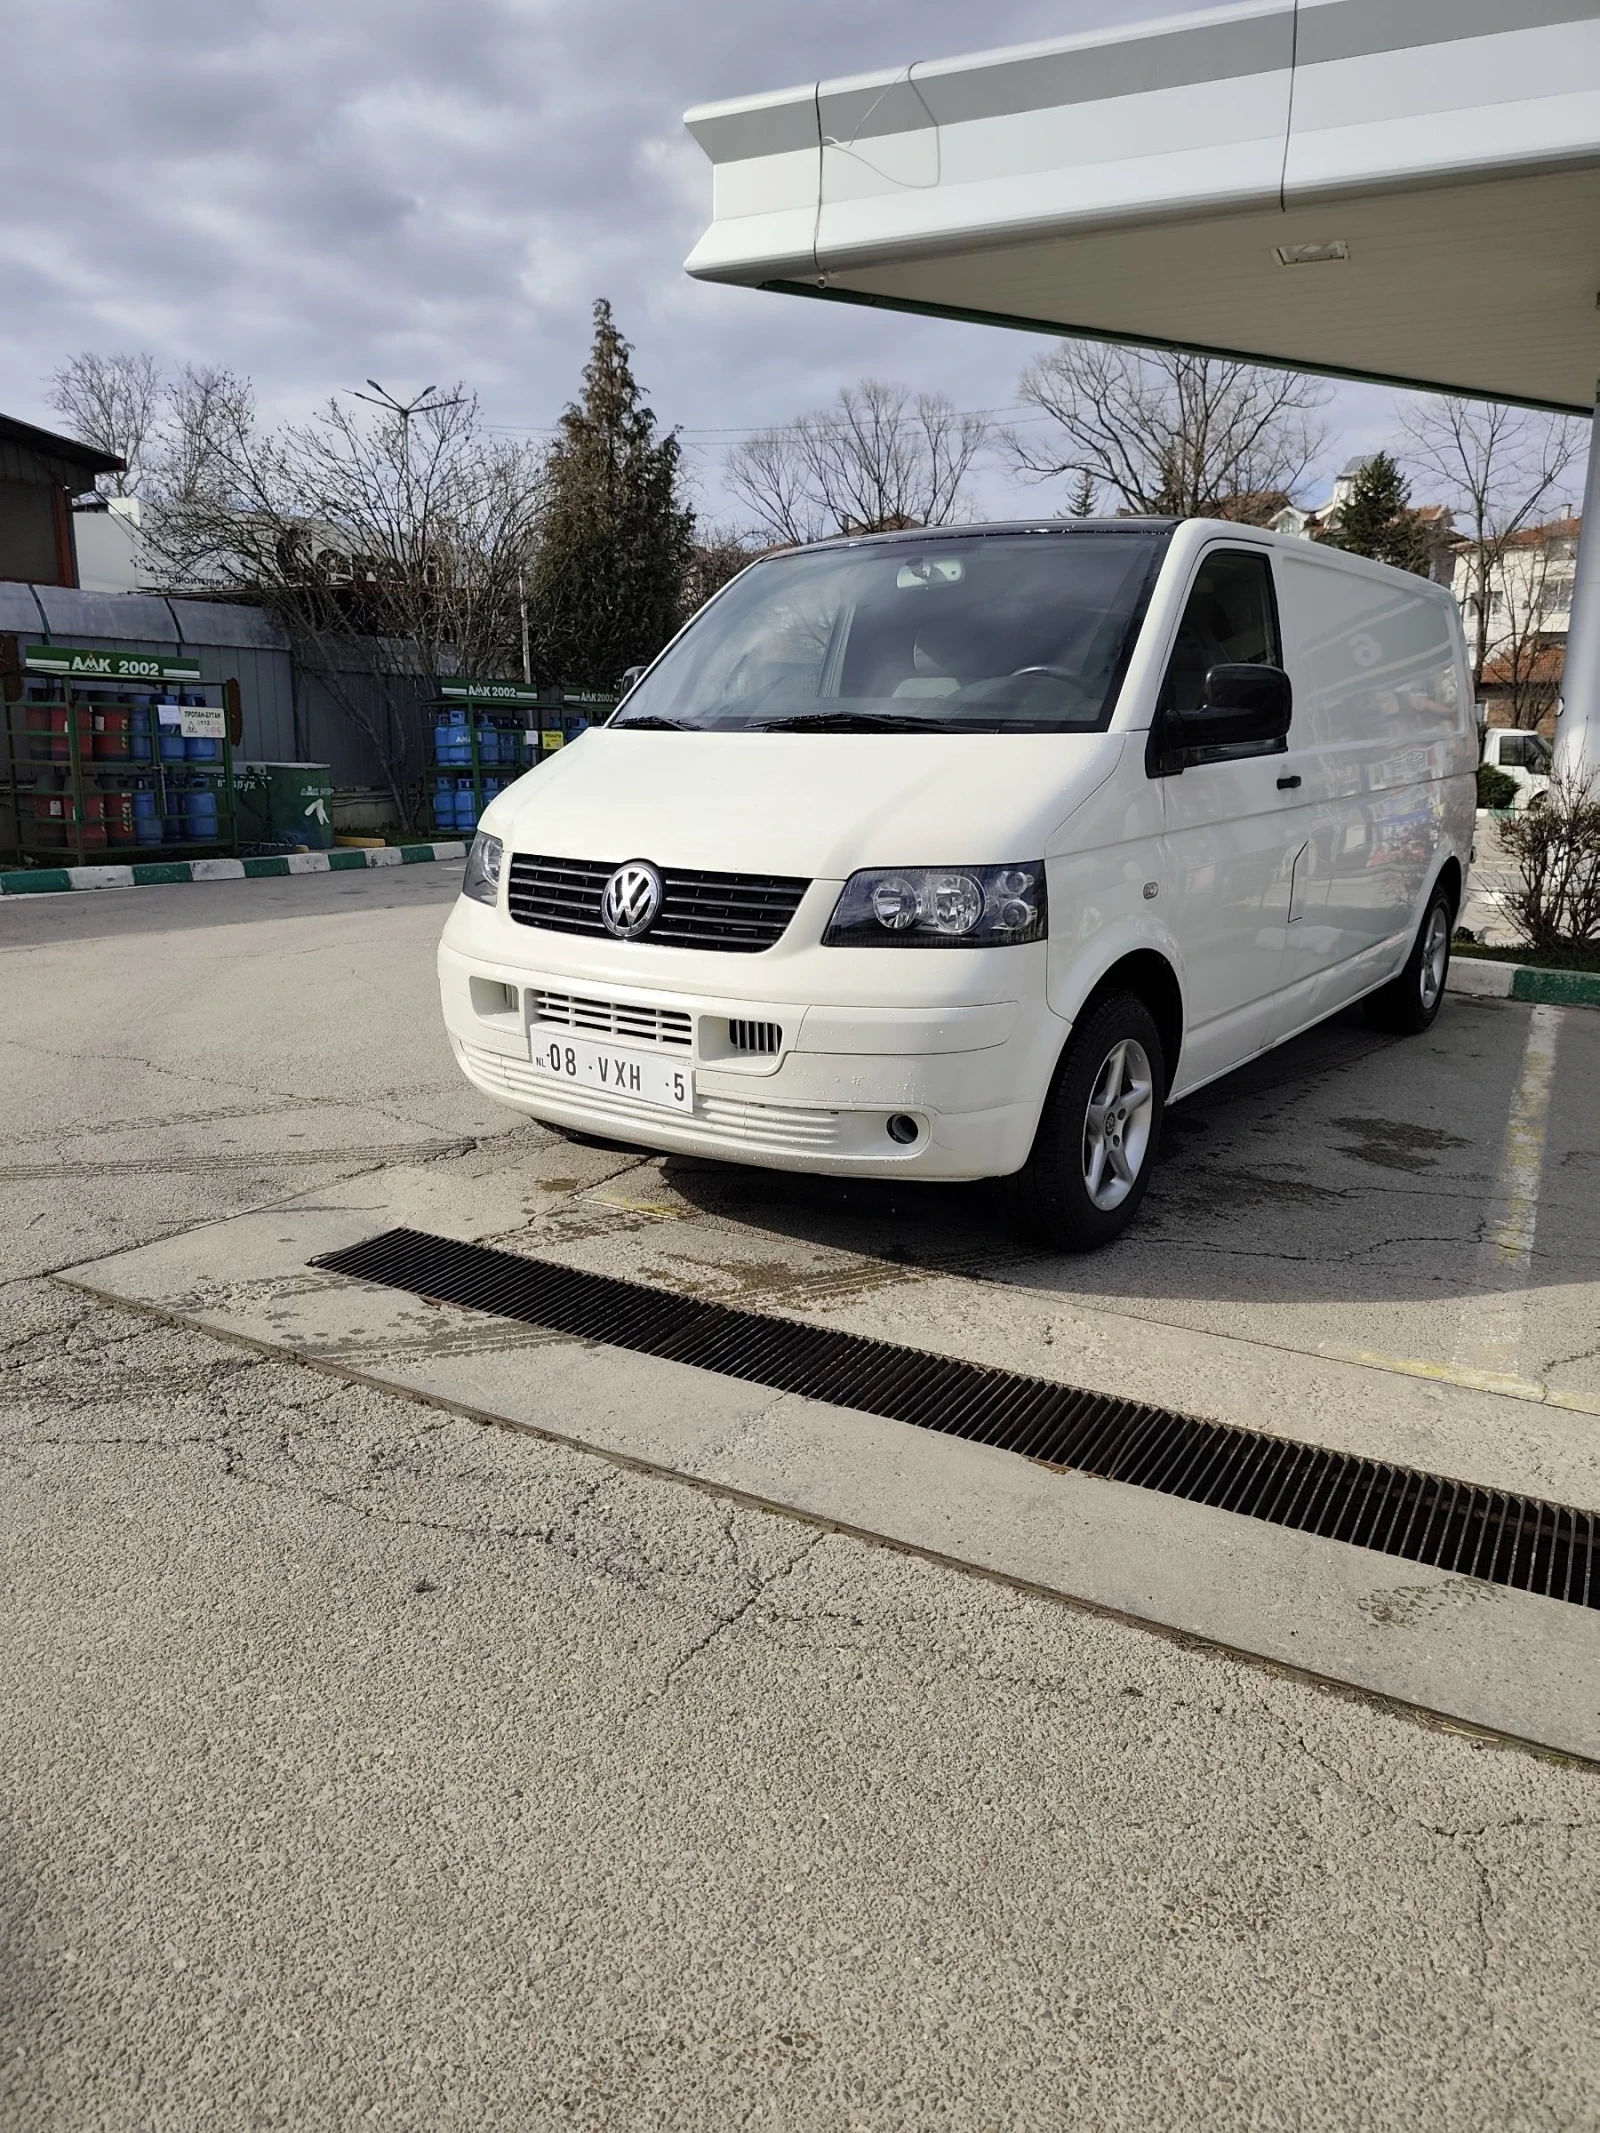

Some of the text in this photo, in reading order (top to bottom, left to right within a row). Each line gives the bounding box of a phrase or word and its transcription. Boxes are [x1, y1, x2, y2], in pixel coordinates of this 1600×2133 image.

[119, 660, 159, 676] 2002
[492, 686, 516, 698] 2002
[597, 694, 614, 702] 2002
[184, 710, 221, 719] ПРОПАН-БУТАН
[536, 1056, 546, 1068] NL
